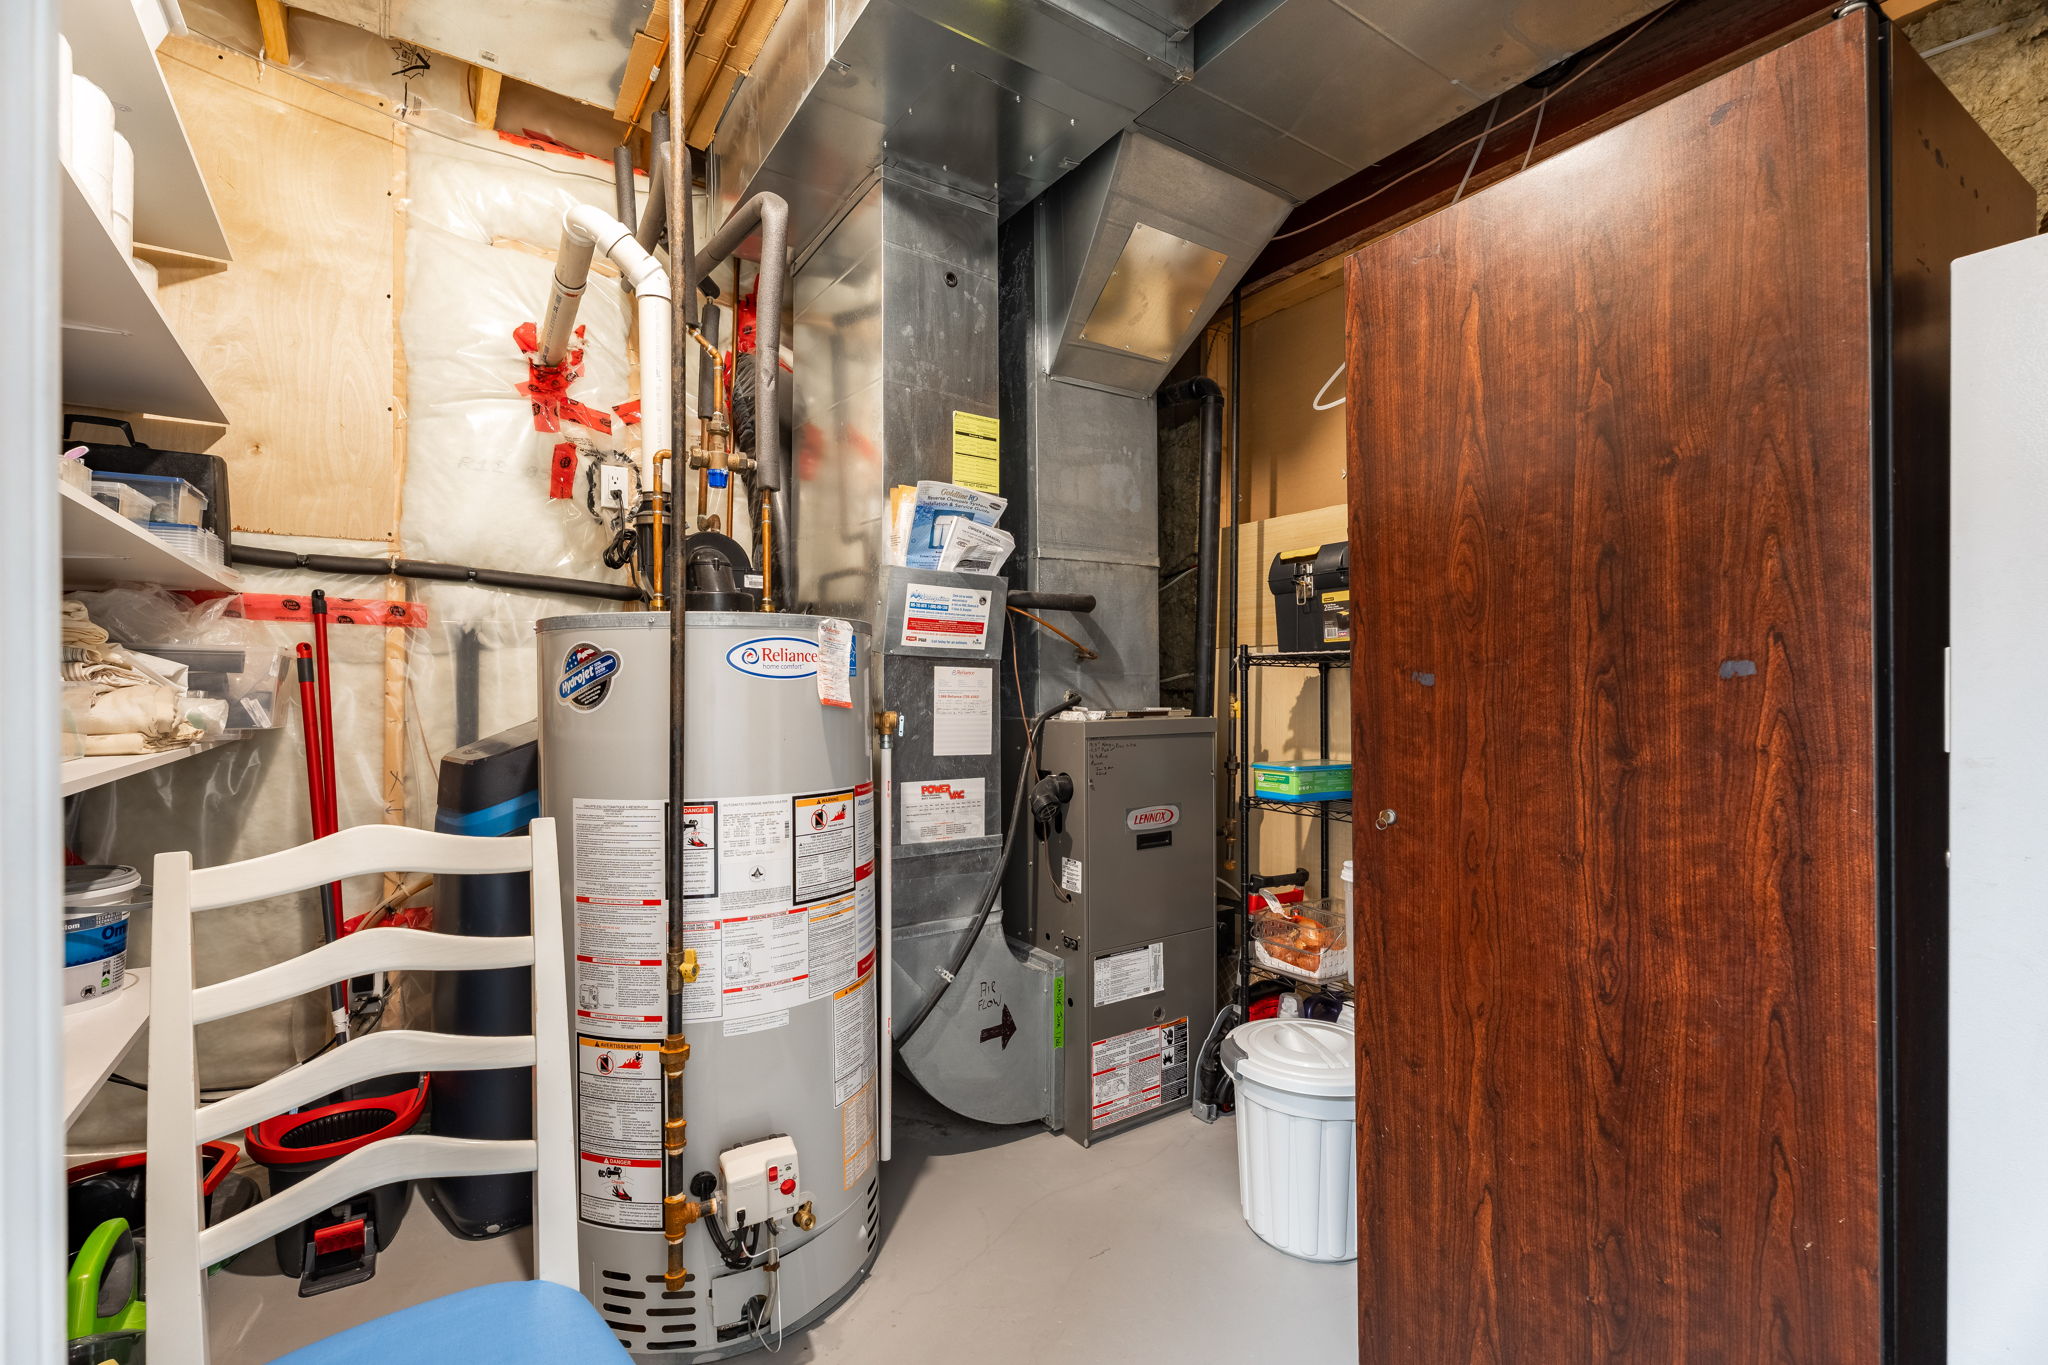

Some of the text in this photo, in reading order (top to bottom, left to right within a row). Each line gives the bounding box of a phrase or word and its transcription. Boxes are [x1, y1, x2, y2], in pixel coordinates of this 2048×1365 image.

[761, 647, 818, 663] Reliance
[562, 665, 595, 694] Hydrojet
[921, 783, 951, 795] POWER
[948, 790, 965, 800] VAC
[1133, 811, 1167, 825] LENNOX
[980, 981, 996, 997] AIR
[978, 995, 1002, 1011] FLOW
[600, 1042, 642, 1050] AVERTISSEMENT
